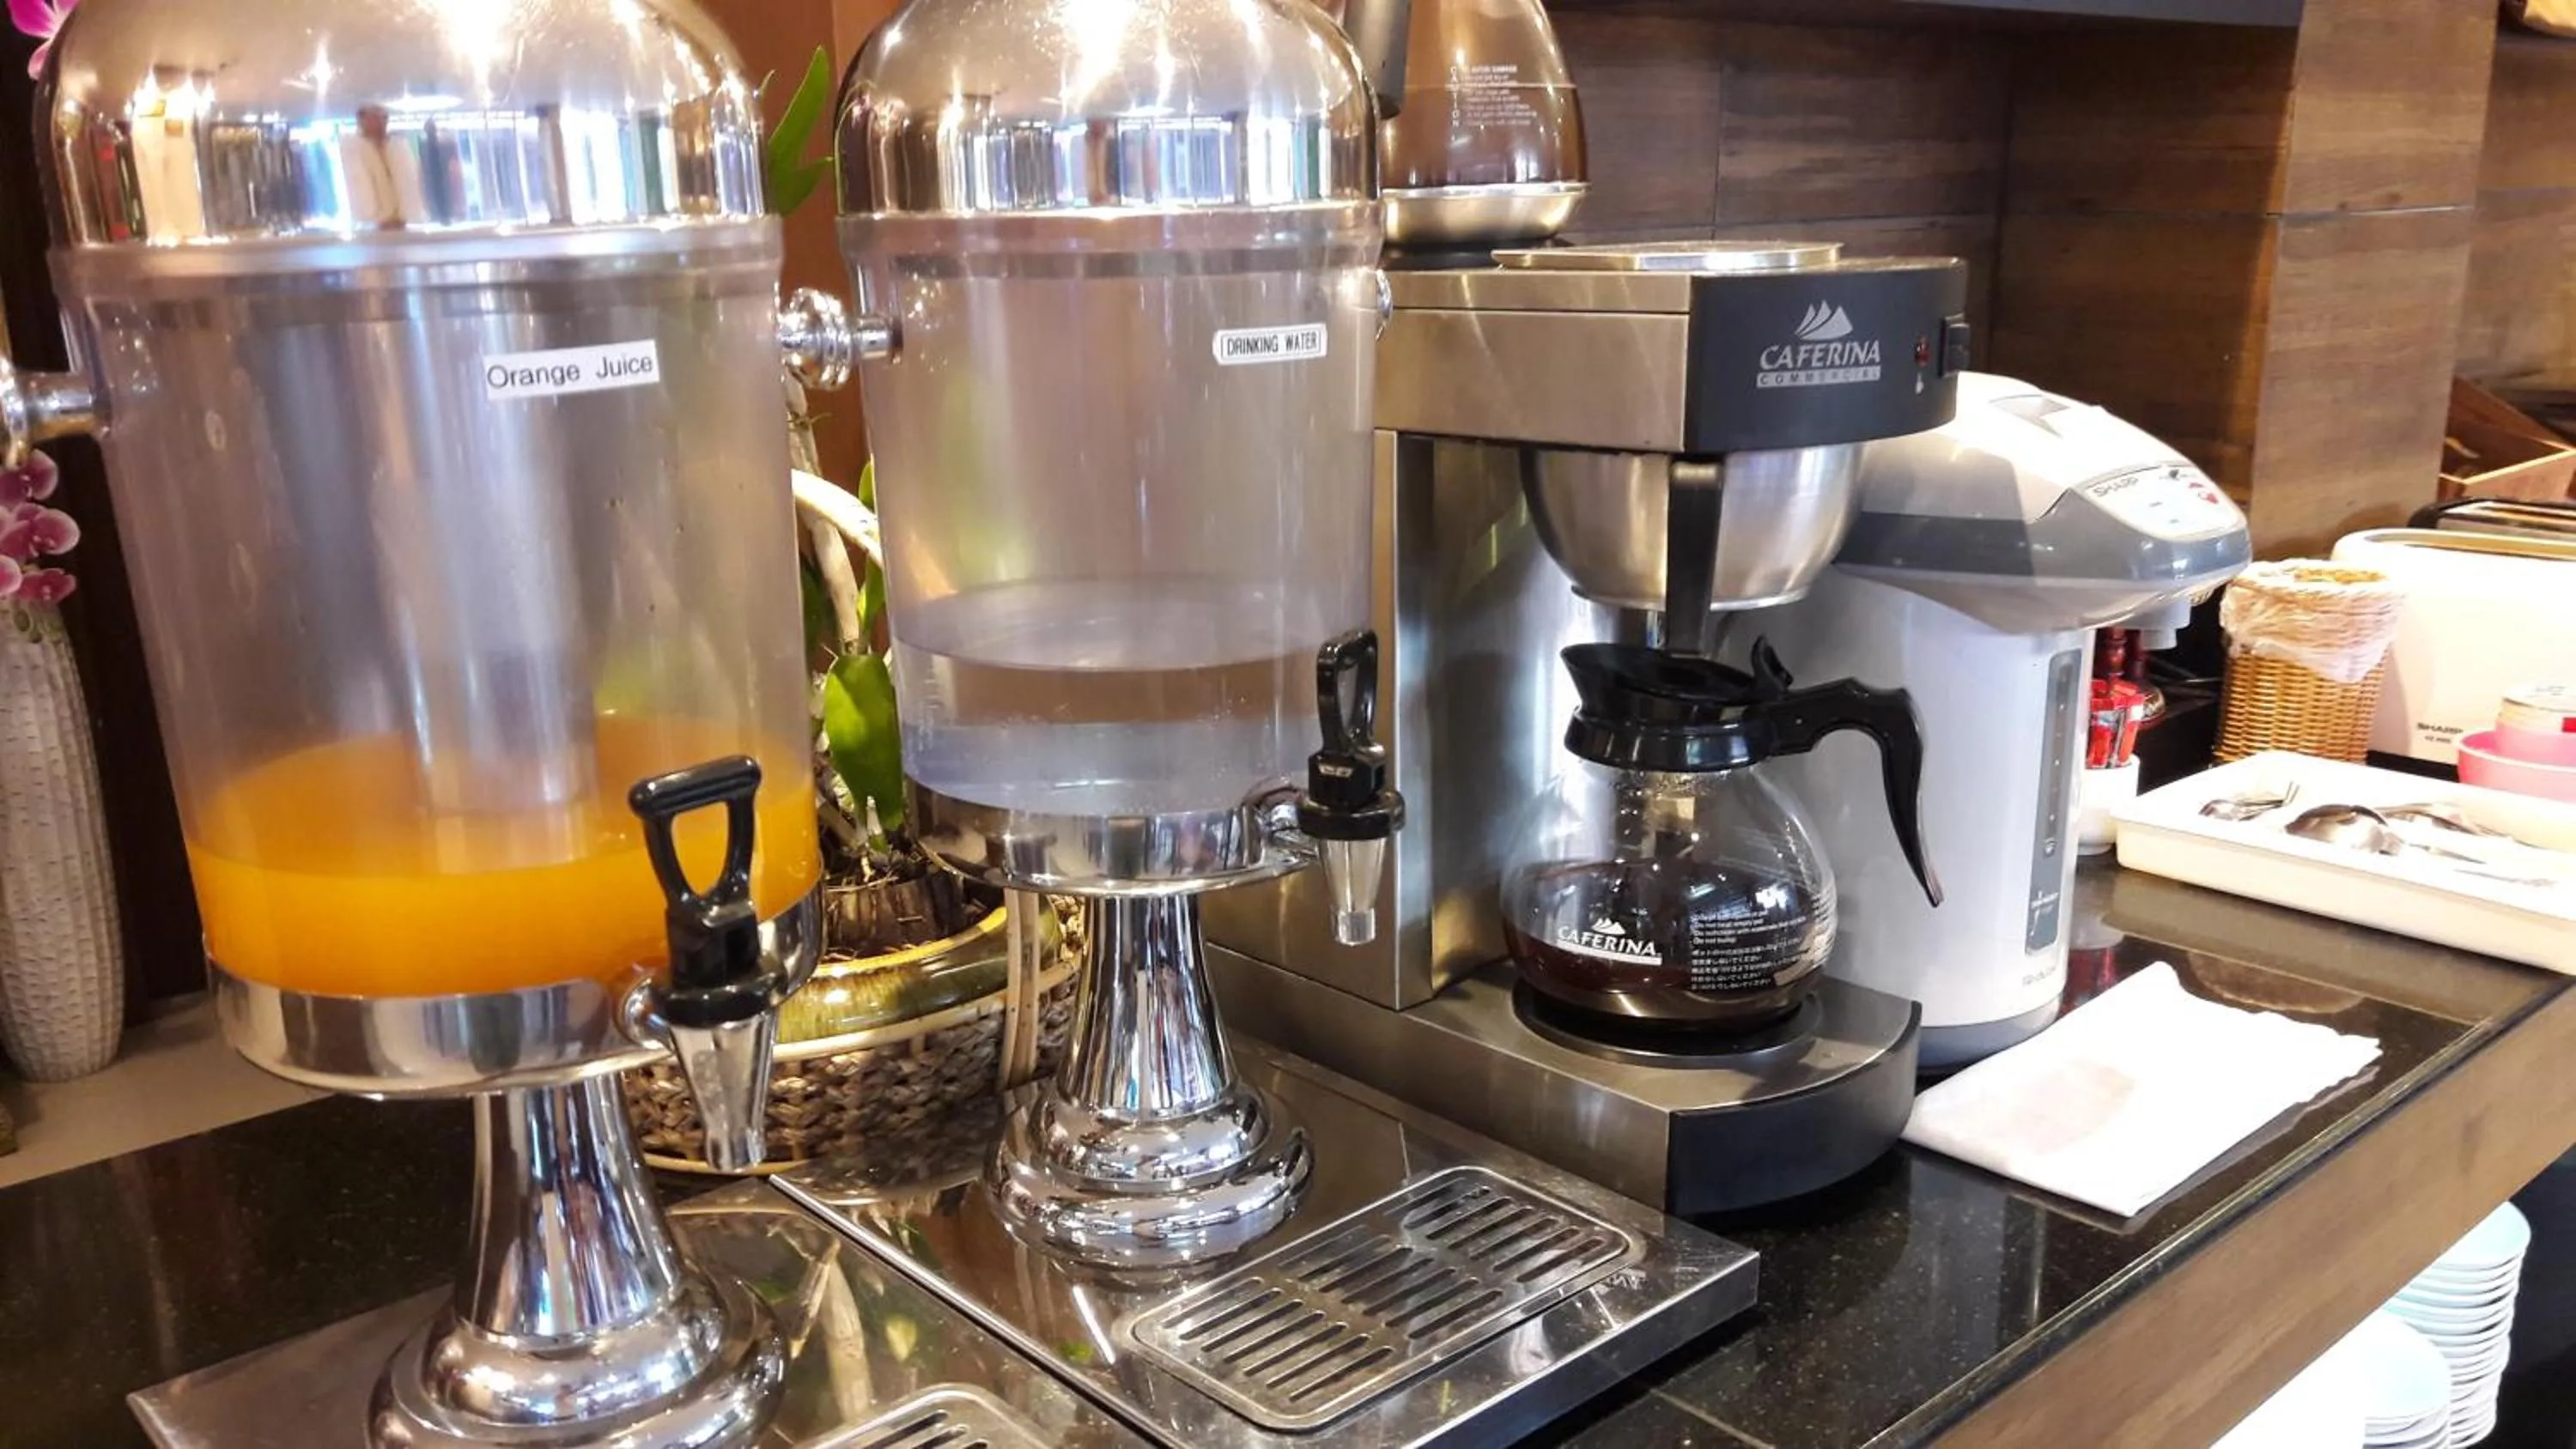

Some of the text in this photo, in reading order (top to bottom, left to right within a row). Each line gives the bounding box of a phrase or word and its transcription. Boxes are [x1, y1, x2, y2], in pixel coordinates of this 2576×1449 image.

[1227, 331, 1317, 356] DRINKING WATER
[1759, 340, 1880, 370] CAFERINA
[487, 355, 653, 389] Orange Juice
[2093, 476, 2139, 497] SHARP
[1558, 925, 1656, 956] CAFERINA
